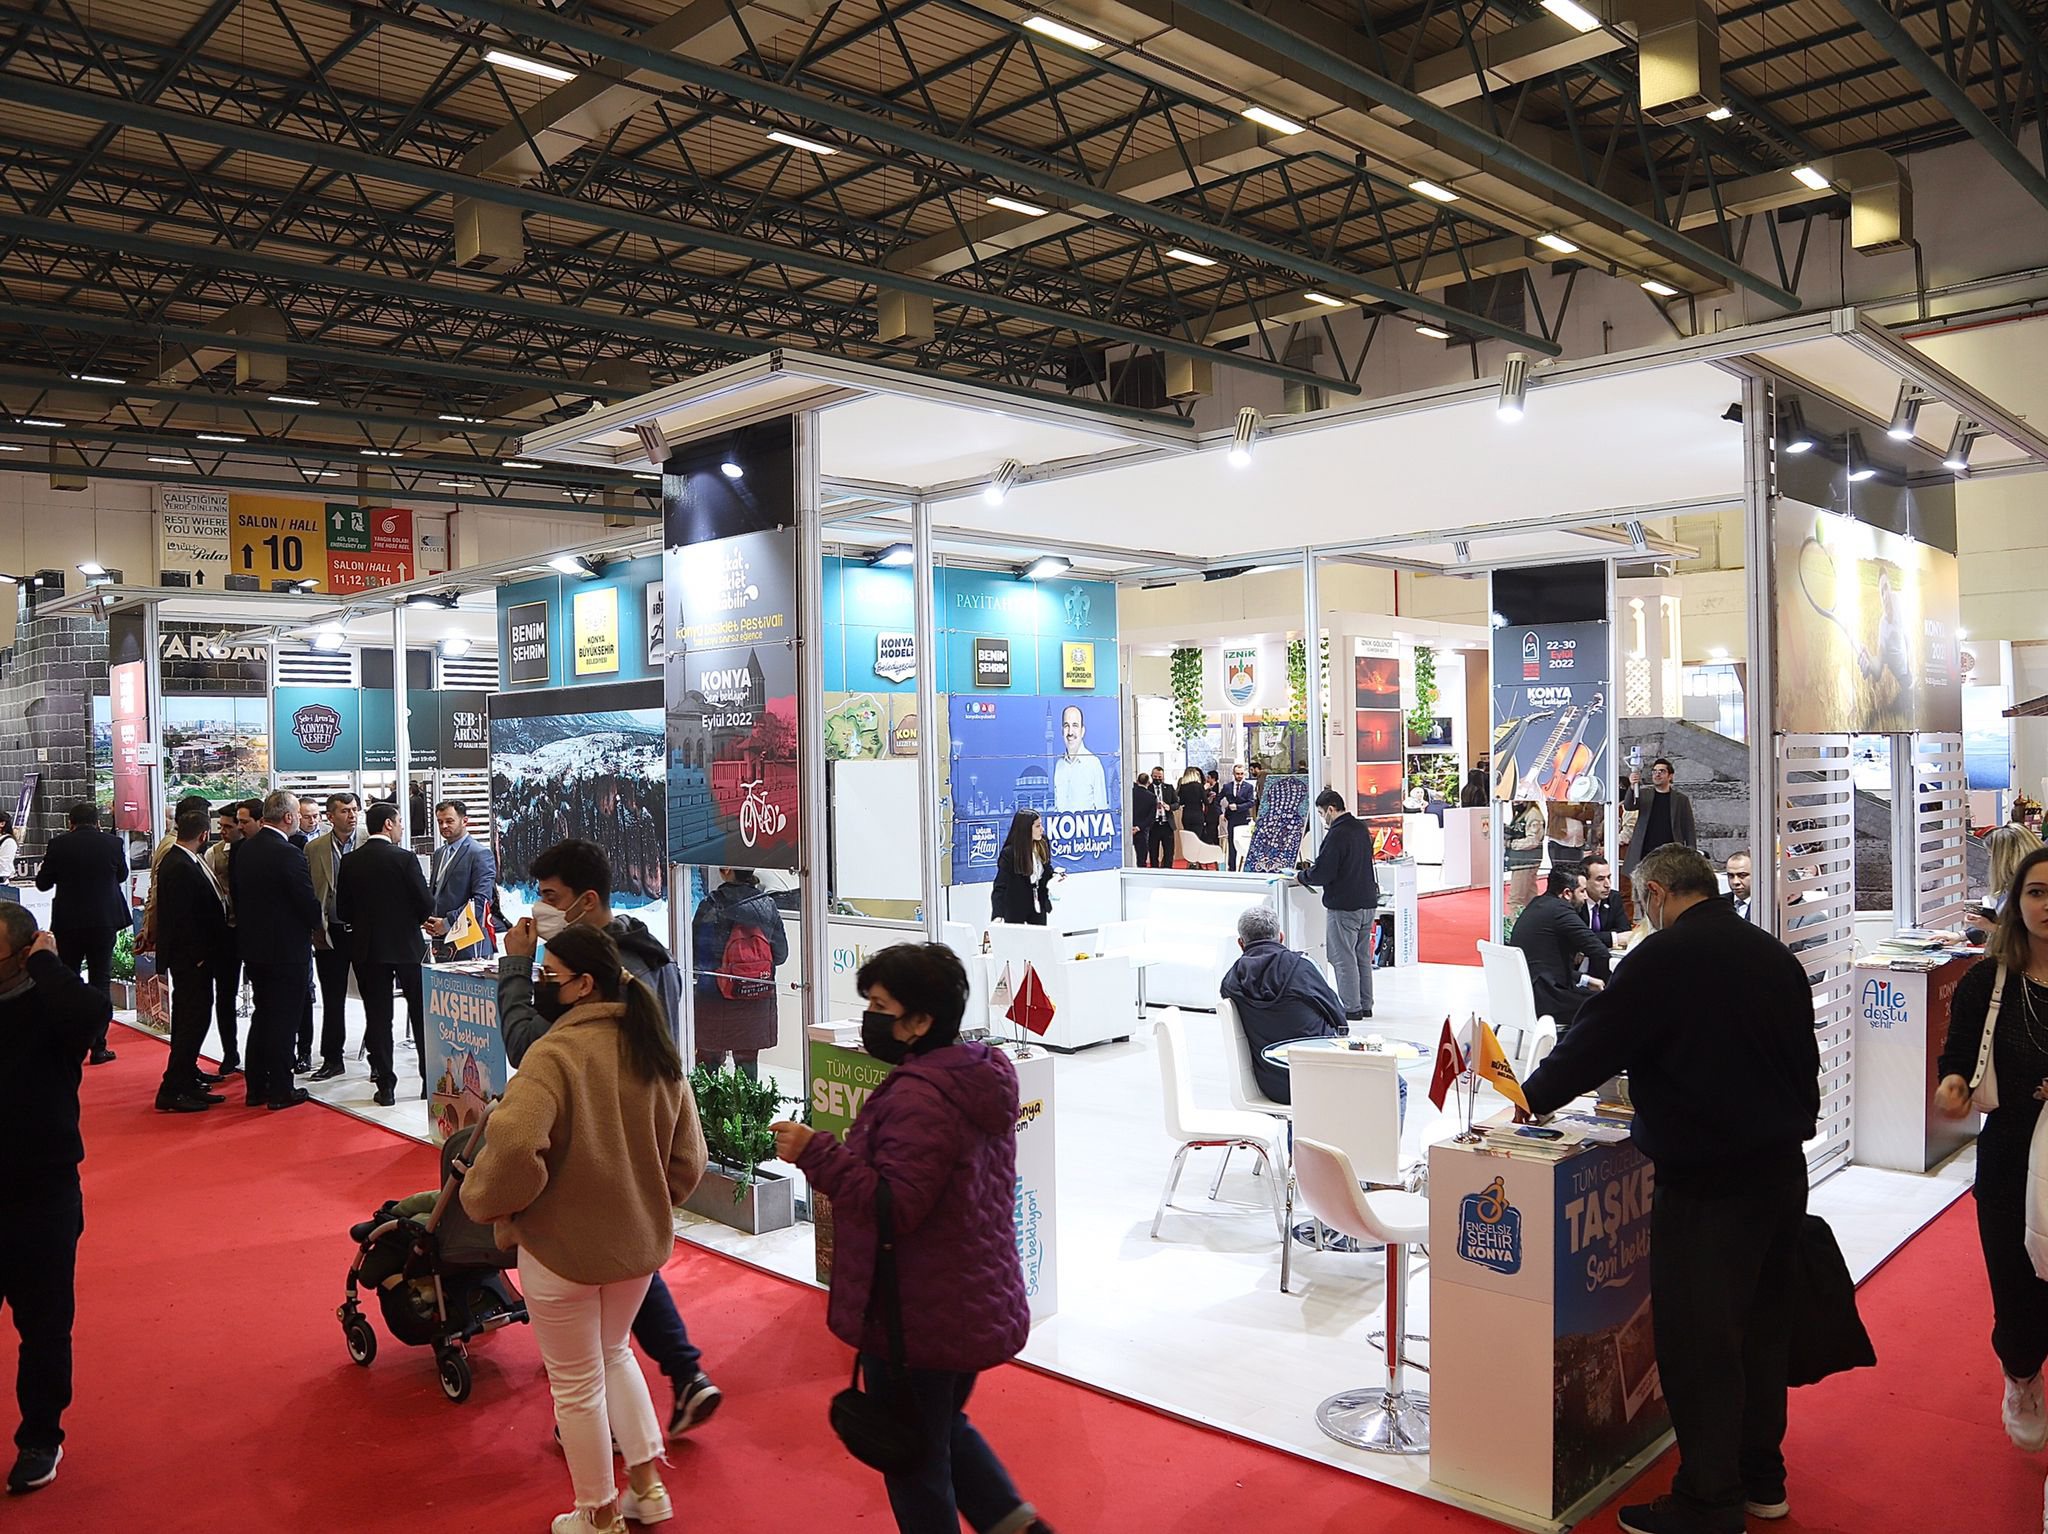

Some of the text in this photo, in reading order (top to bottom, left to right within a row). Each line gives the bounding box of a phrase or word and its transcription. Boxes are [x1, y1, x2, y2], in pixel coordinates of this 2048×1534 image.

[165, 516, 227, 527] REST WHERE
[167, 525, 227, 536] YOU WORK
[239, 515, 277, 529] SALON
[289, 519, 318, 532] HALL
[263, 534, 303, 571] 10
[740, 614, 783, 631] festivali
[512, 622, 545, 644] BENİM
[588, 635, 605, 644] KONYA
[881, 638, 913, 648] KONYA
[1546, 640, 1576, 650] 22-30
[513, 644, 545, 664] ŞEHRİM
[880, 648, 913, 658] MODELİ
[978, 649, 1007, 661] BENİM
[1226, 650, 1255, 658] İZNİK
[1551, 650, 1573, 659] Eylül
[978, 662, 1007, 674] ŞEHRİM
[1549, 659, 1574, 668] 2022
[701, 668, 752, 691] KONYA
[703, 687, 750, 707] Seni bekliyor!
[1527, 687, 1572, 699] KONYA
[702, 712, 752, 731] Eylül 2022
[1046, 814, 1115, 840] KONYA
[1050, 836, 1112, 858] Seni bekliyor!
[430, 975, 443, 988] TÜM
[1862, 979, 1906, 1008] Aile
[430, 988, 497, 1028] AKŞEHİR
[1864, 1003, 1908, 1022] dostu
[439, 1022, 490, 1055] Seni bekliyor!
[827, 1057, 889, 1086] TÜM GÜZE
[1572, 1165, 1598, 1195] TÜM
[1565, 1162, 1656, 1254] TAŞKE
[1466, 1222, 1512, 1236] ENGELSİZ
[1025, 1189, 1042, 1297] Seni bekliyor!
[1468, 1246, 1514, 1262] KONYA
[1587, 1249, 1618, 1292] Seni
